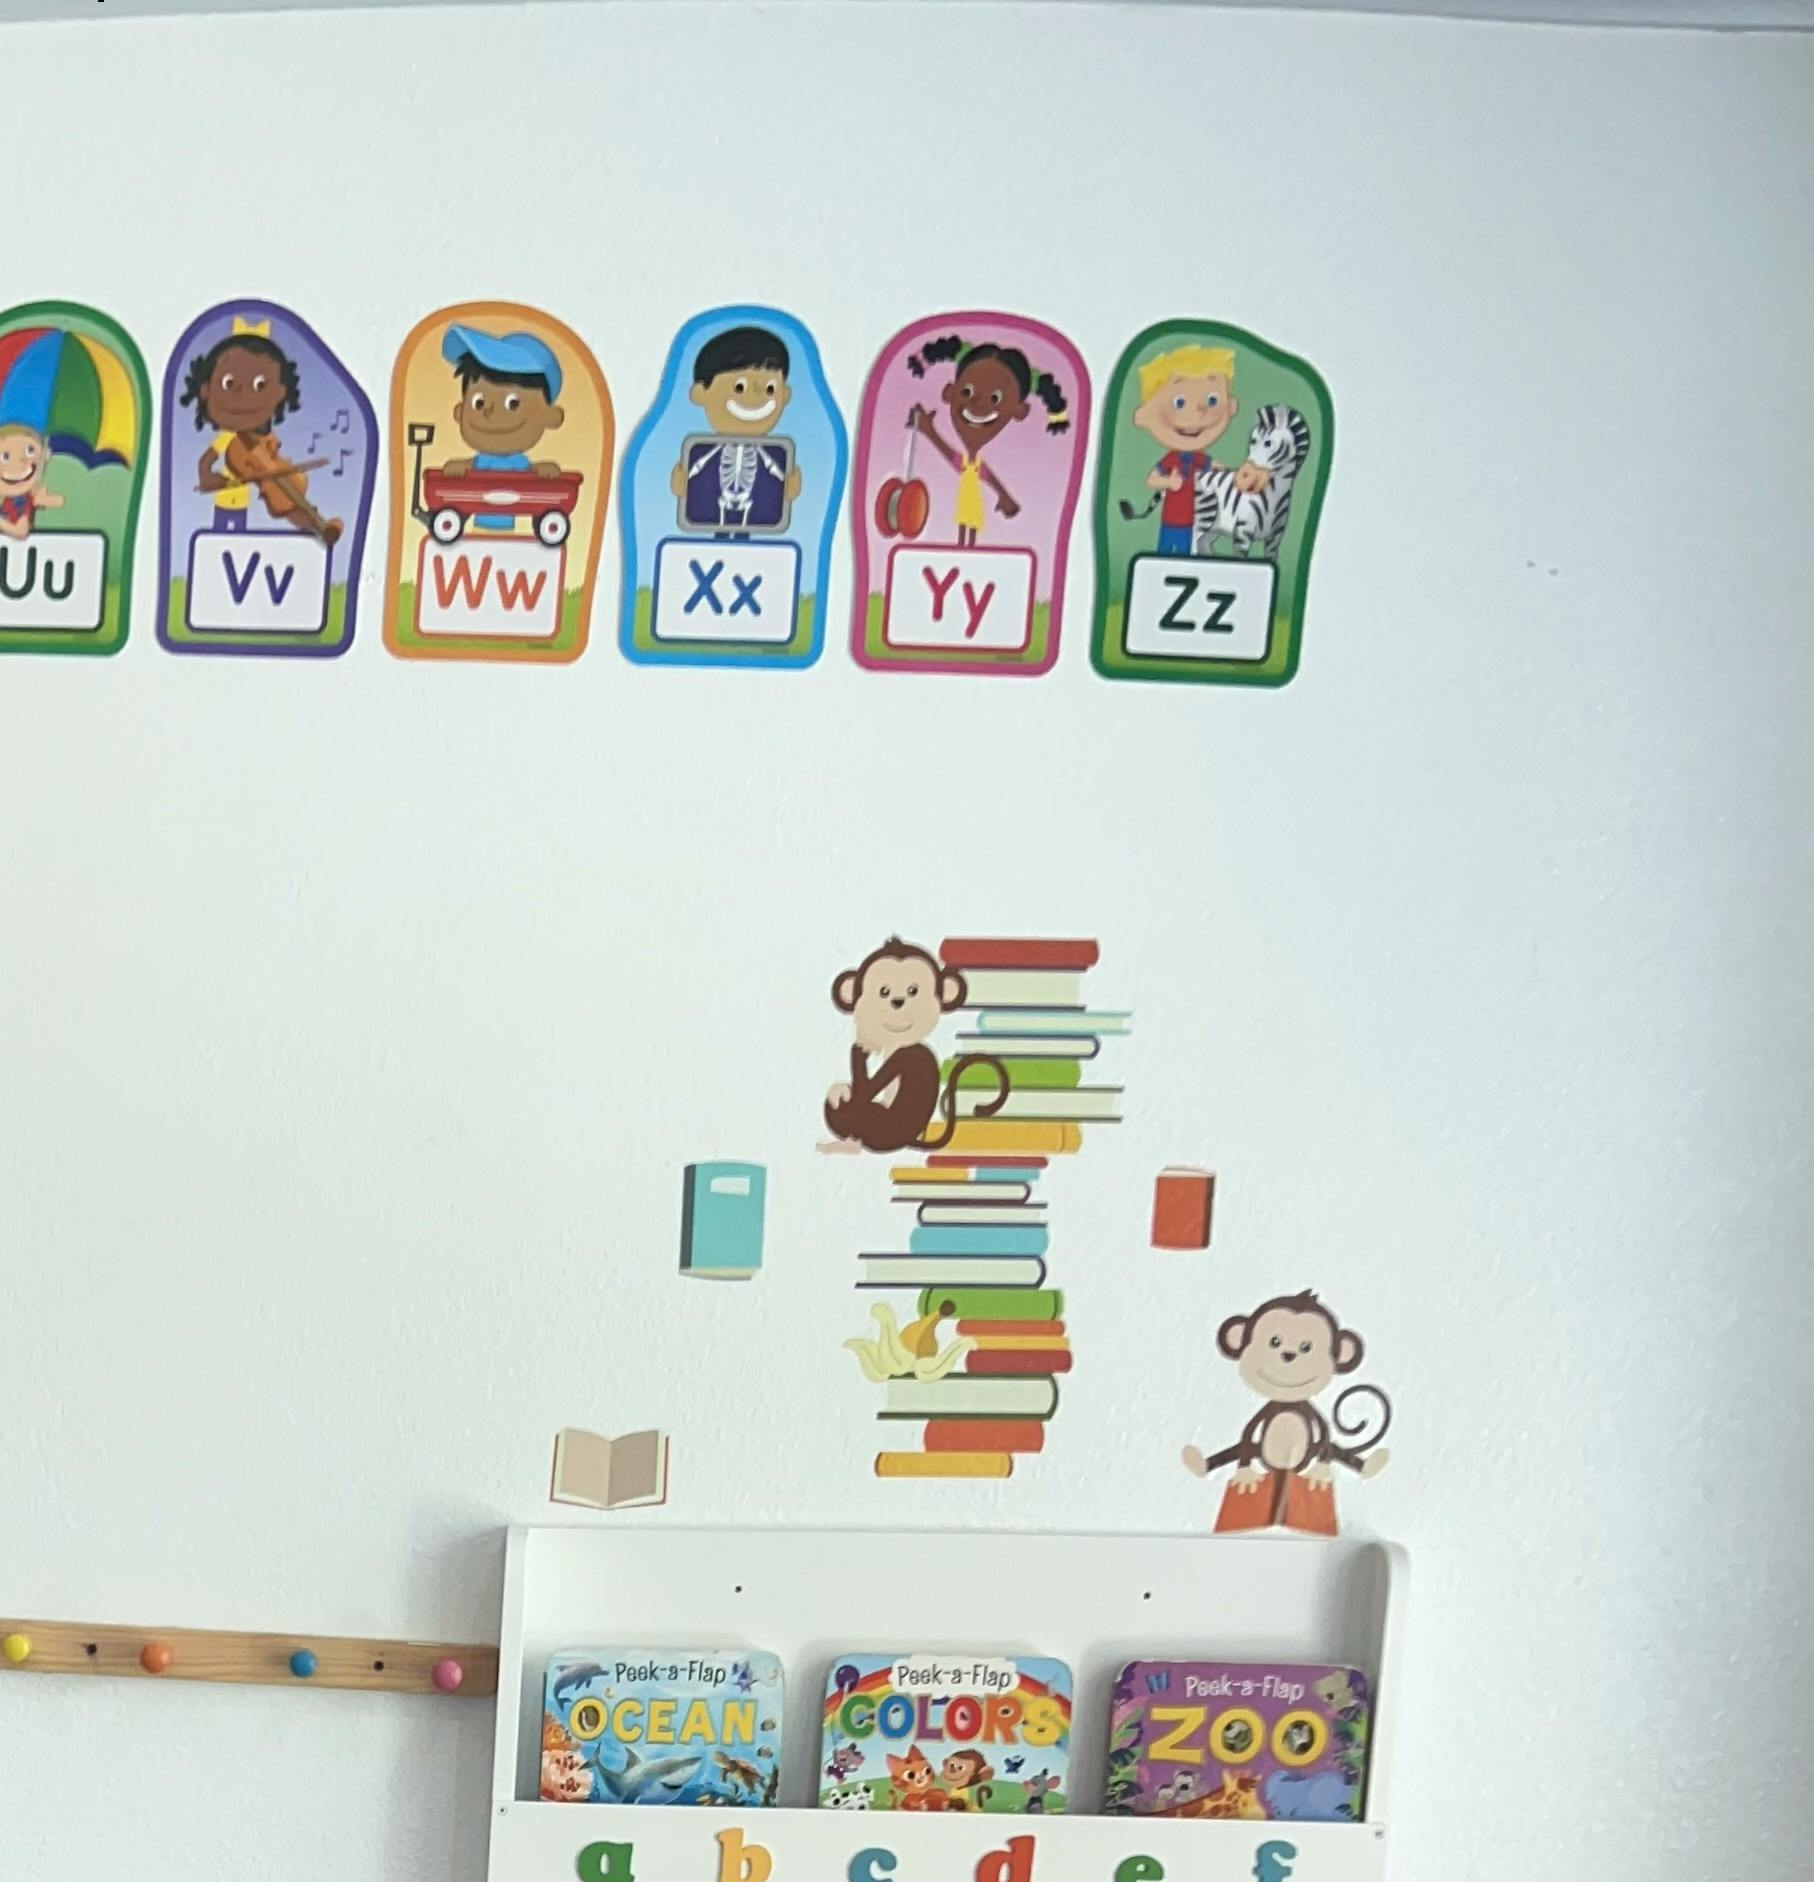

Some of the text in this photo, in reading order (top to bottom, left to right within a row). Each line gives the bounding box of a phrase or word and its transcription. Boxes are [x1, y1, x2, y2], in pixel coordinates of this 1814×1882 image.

[221, 551, 296, 605] Vv
[432, 552, 550, 613] Ww
[683, 557, 761, 615] Xx
[923, 563, 996, 636] Yy
[1162, 575, 1236, 634] Zz
[616, 1660, 727, 1687] Peek-a-Flap
[897, 1664, 1012, 1689] Peek-a-Flap
[1185, 1675, 1305, 1704] Peek-a-Flap
[569, 1696, 757, 1744] OCEAN
[839, 1693, 1062, 1747] COLORS
[1148, 1705, 1330, 1768] ZOO
